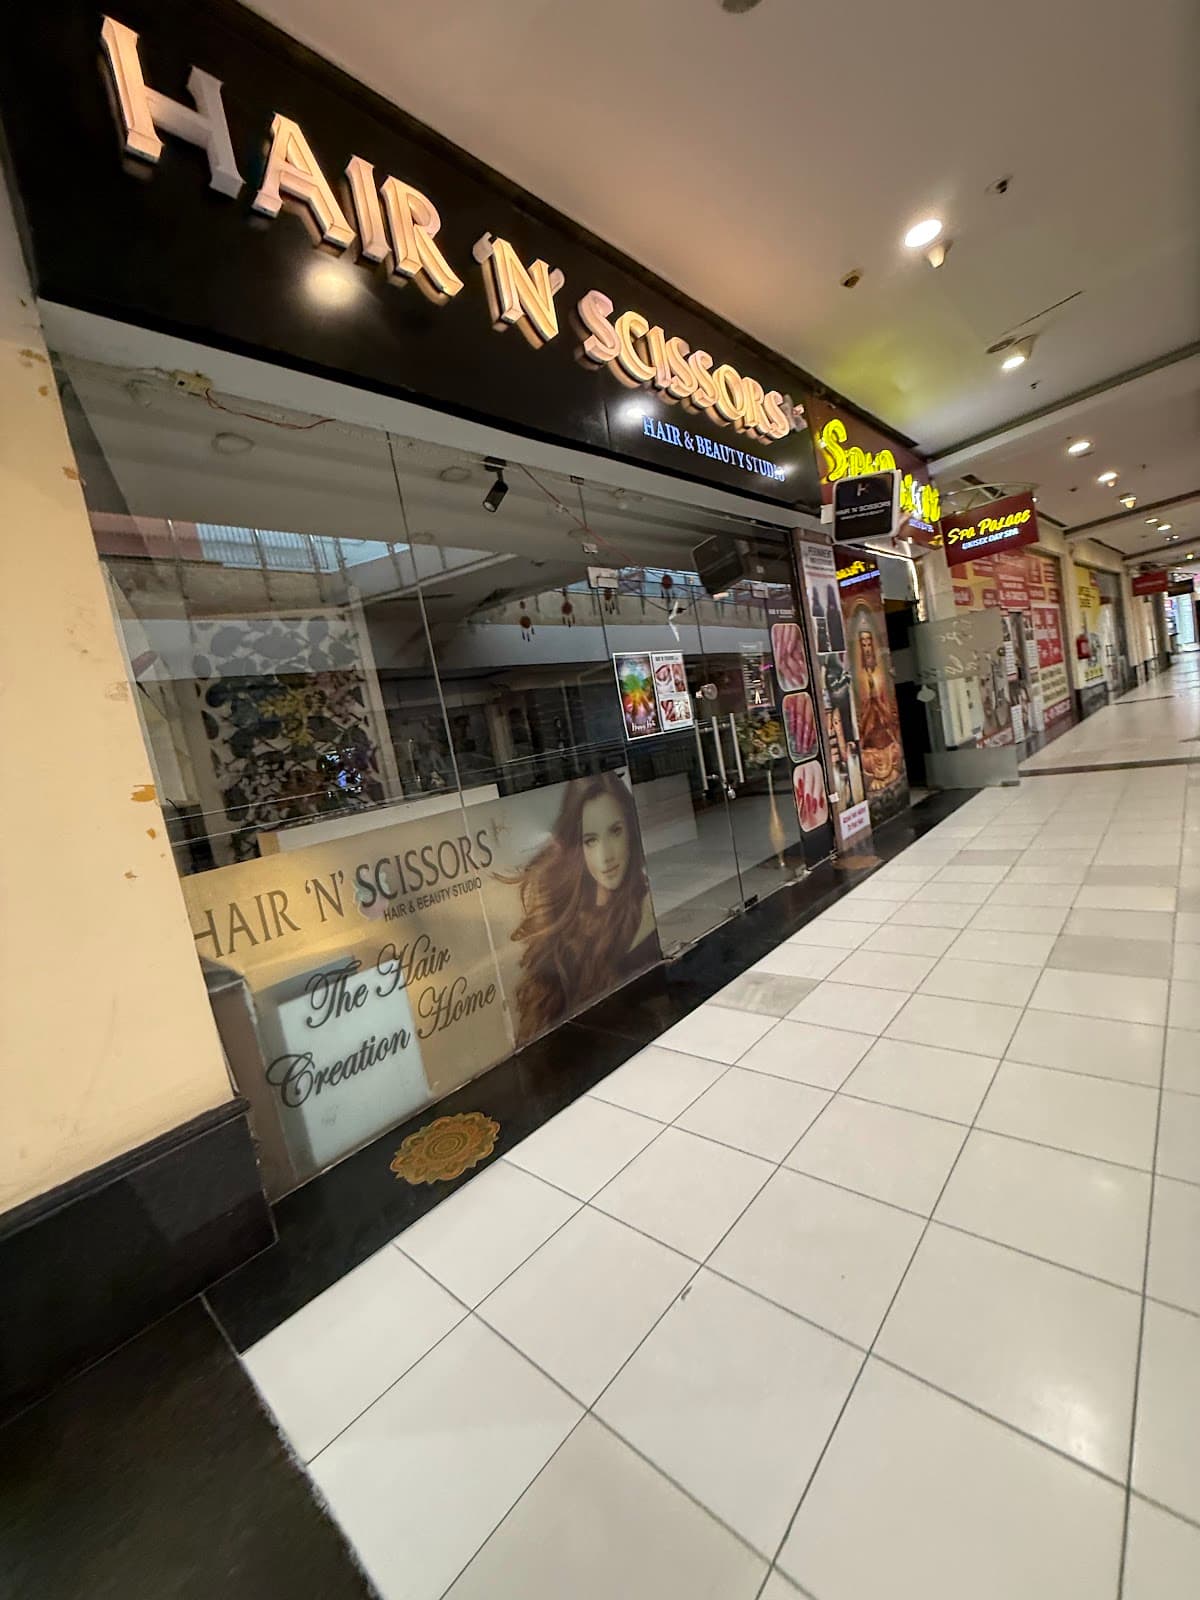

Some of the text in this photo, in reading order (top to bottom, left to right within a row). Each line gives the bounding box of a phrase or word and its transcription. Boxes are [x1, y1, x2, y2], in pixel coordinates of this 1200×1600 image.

[101, 14, 464, 297] HAIR
[577, 289, 790, 440] SCISSORS
[642, 414, 683, 447] HAIR
[683, 430, 695, 452] &
[695, 434, 746, 468] BEAUTY
[193, 889, 301, 958] HAIR
[355, 829, 493, 908] SCISSORS
[384, 876, 482, 922] HAIR & BEAUTY STUDIO
[304, 934, 451, 1028] The Hair
[265, 976, 496, 1108] Creation Home
